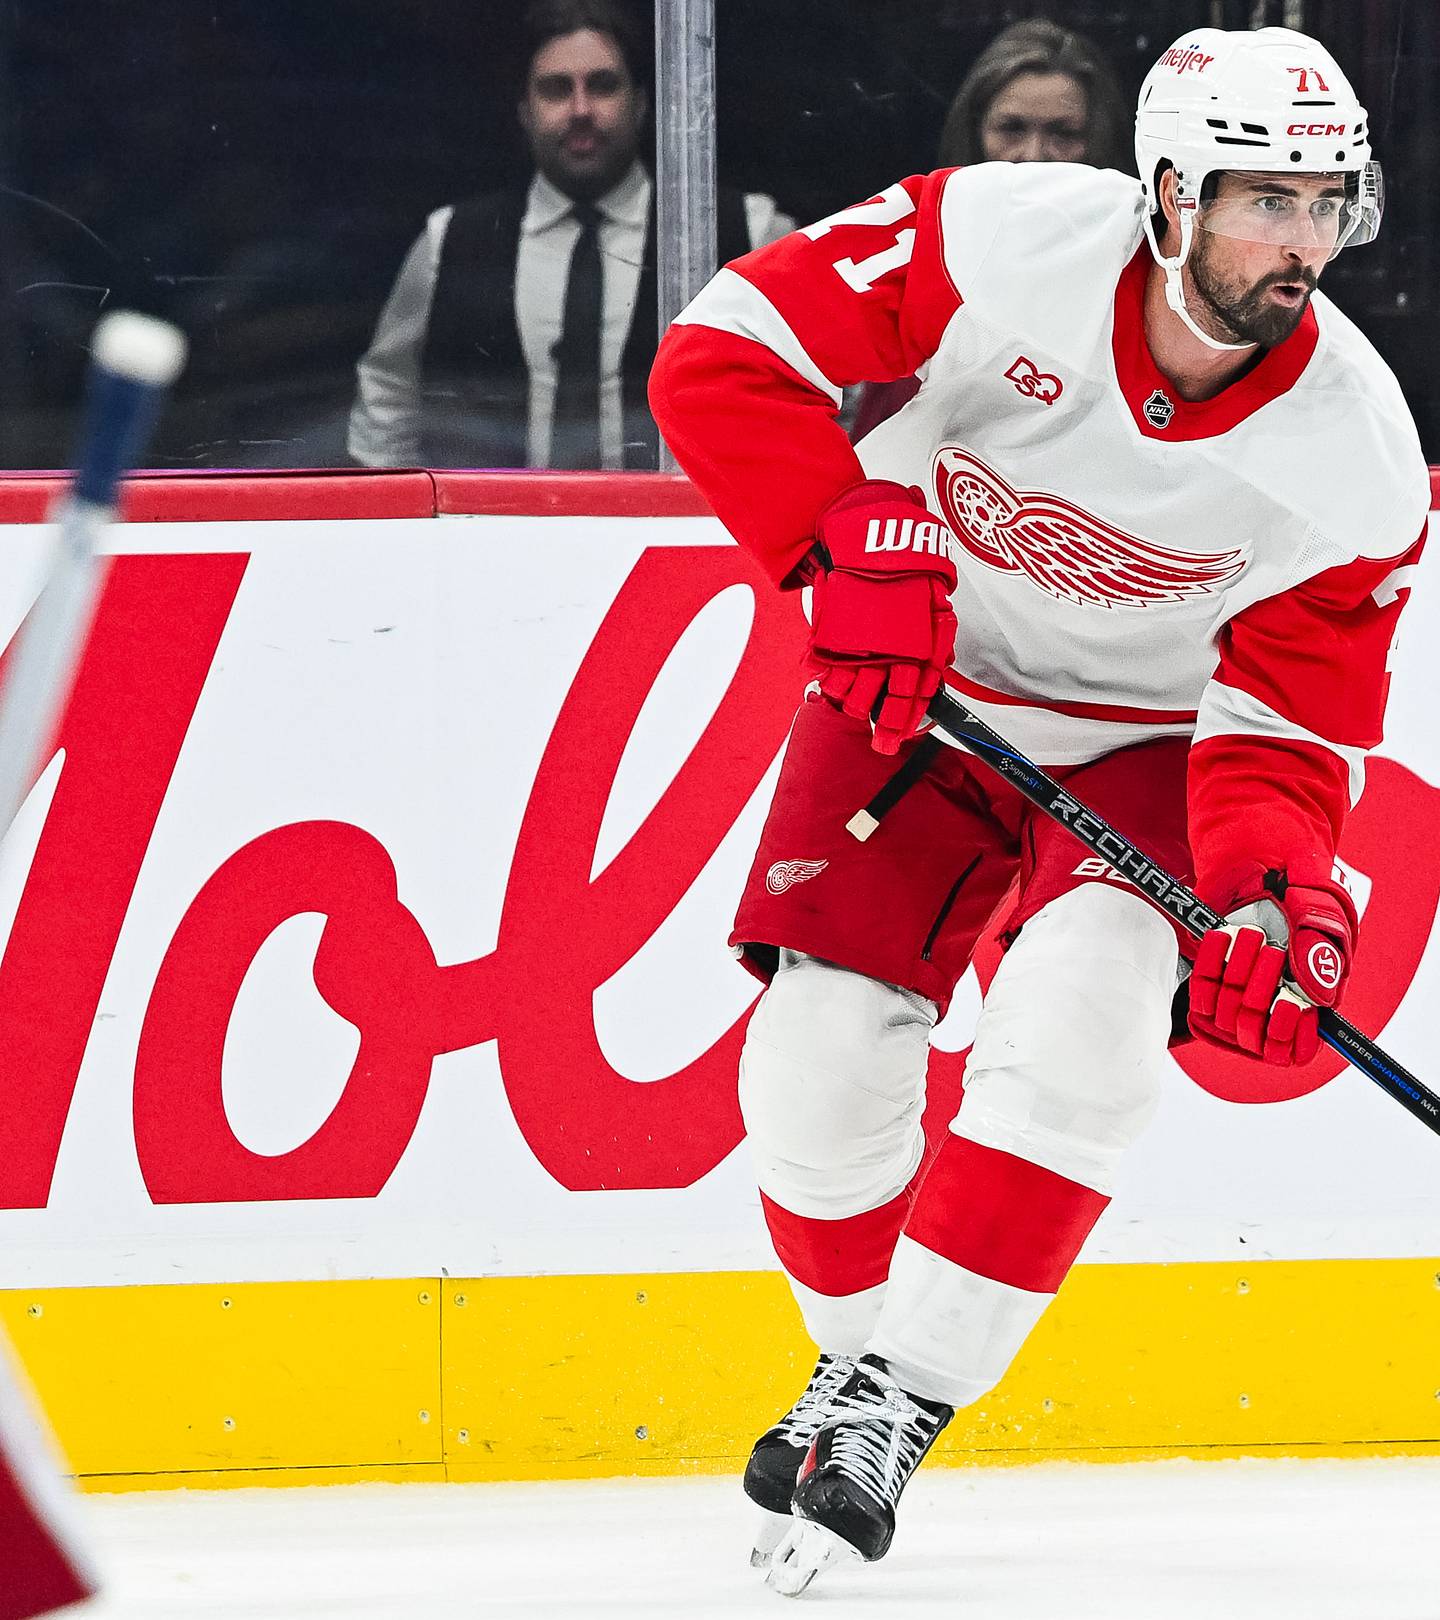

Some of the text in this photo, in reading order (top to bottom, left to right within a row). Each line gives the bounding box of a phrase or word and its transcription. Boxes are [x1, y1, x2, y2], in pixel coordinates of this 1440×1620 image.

[1157, 45, 1214, 75] meijer
[1286, 67, 1330, 92] 71
[1287, 124, 1346, 136] CCM
[795, 183, 917, 294] 71
[1148, 405, 1169, 416] NHL
[1337, 1029, 1440, 1117] SUPERCHARGED MK
